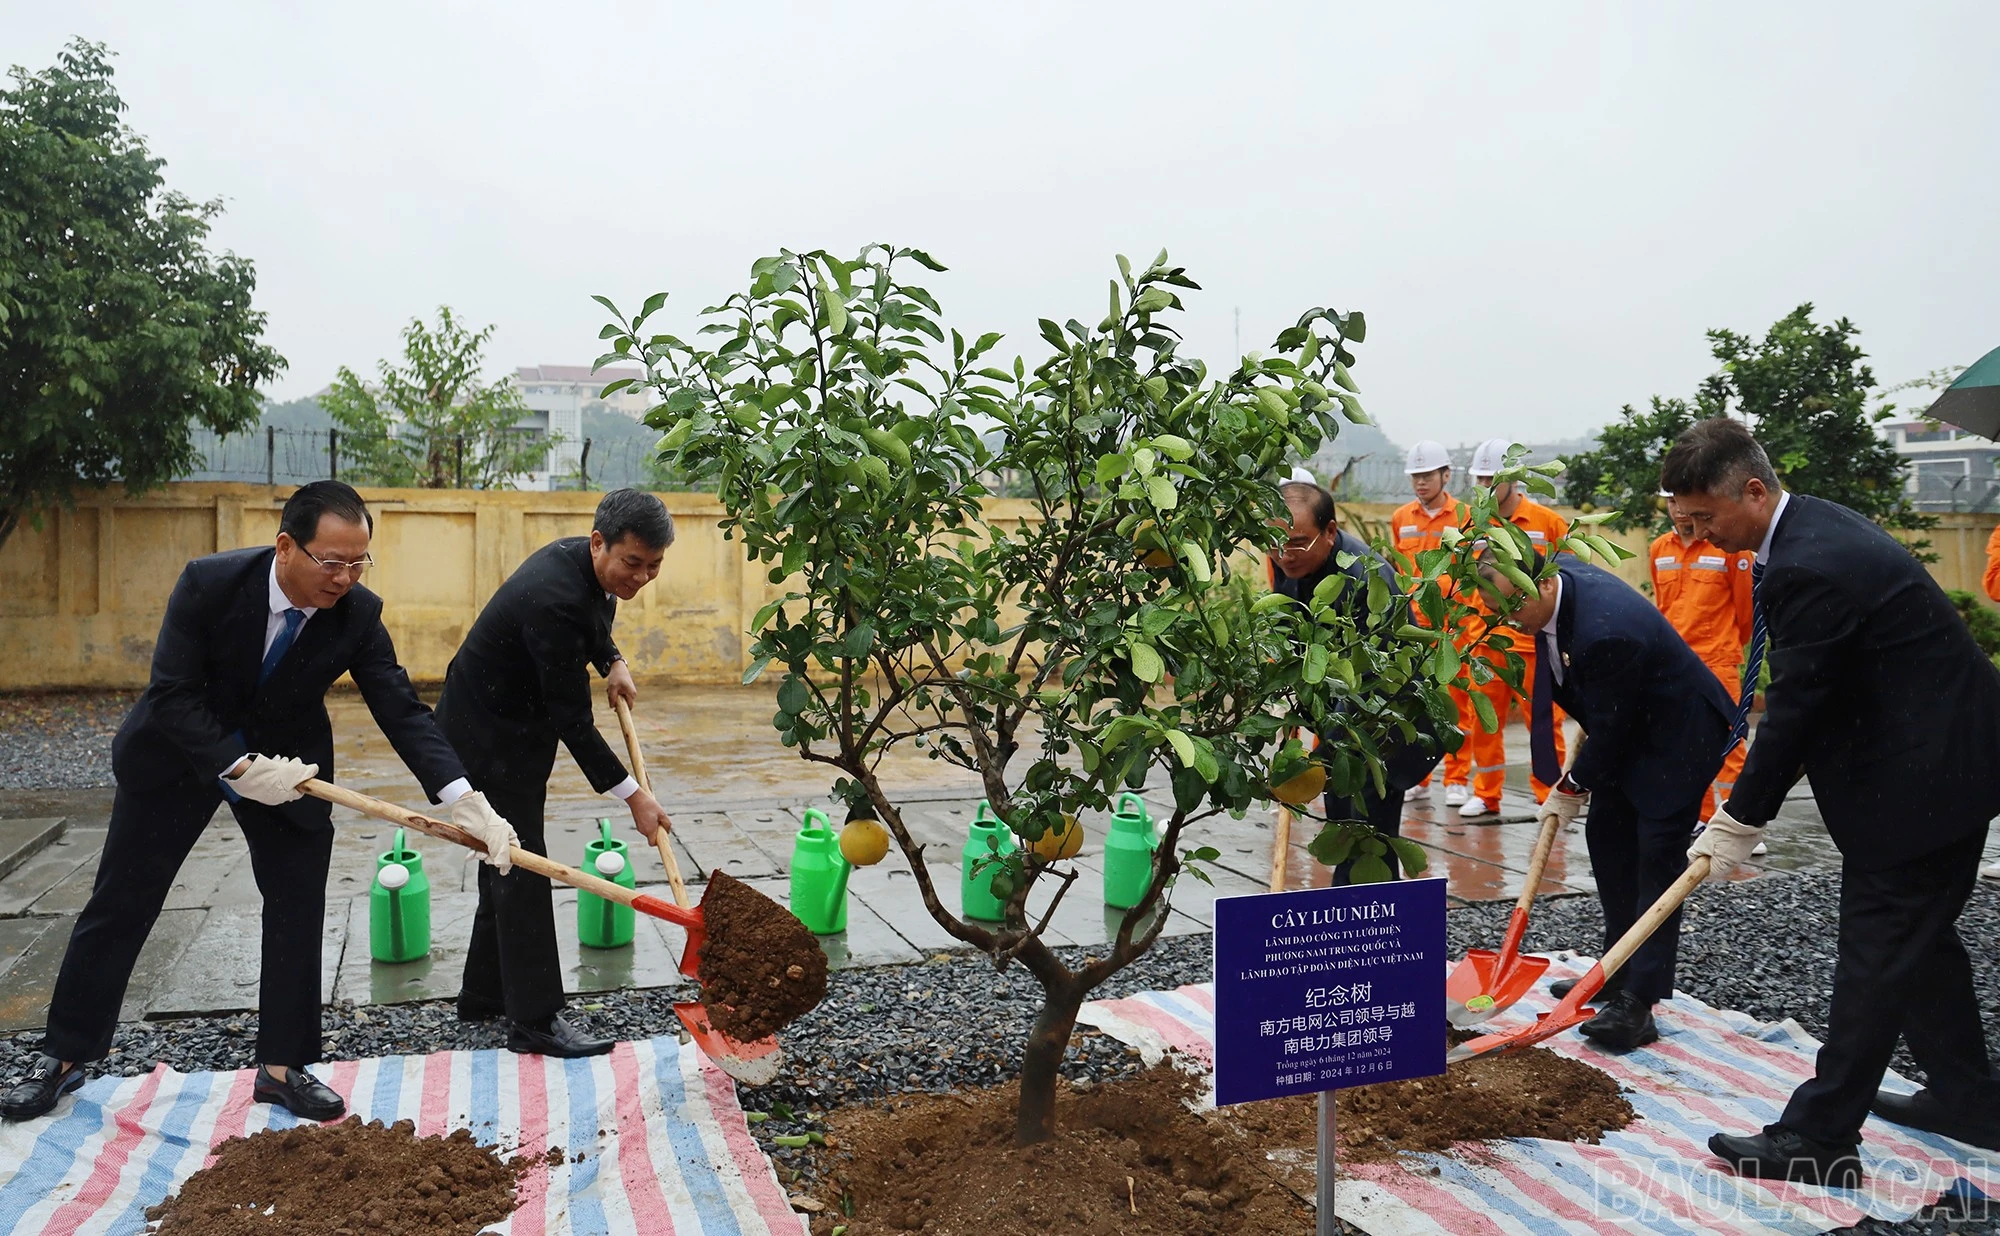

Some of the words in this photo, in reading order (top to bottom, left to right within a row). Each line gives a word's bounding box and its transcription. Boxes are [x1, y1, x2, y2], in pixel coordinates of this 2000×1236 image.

[1272, 909, 1308, 929] CÂY
[1312, 906, 1347, 925] LƯU
[1351, 901, 1396, 922] NIỆM
[1265, 937, 1291, 948] LÃNH
[1314, 931, 1340, 942] CÔNG
[1342, 930, 1354, 939] TY
[1356, 927, 1378, 938] LƯỚI
[1265, 950, 1304, 963] PHƯƠNG
[1306, 948, 1327, 958] NAM
[1330, 945, 1360, 955] TRUNG
[1362, 939, 1387, 953] QUỐC
[1389, 938, 1401, 949] VÀ
[1241, 969, 1267, 980] LÃNH
[1291, 964, 1309, 976] TẬP
[1362, 955, 1380, 967] LỰC
[1381, 954, 1402, 964] VIỆT
[1404, 952, 1424, 961] NAM
[1305, 981, 1372, 1008] 纪念树
[1260, 1002, 1416, 1037] 南方电网公司领导与越
[1284, 1026, 1393, 1055] 南电力集团领导
[1300, 1057, 1317, 1068] ngày
[1325, 1054, 1345, 1064] tháng
[1374, 1047, 1391, 1056] 2024
